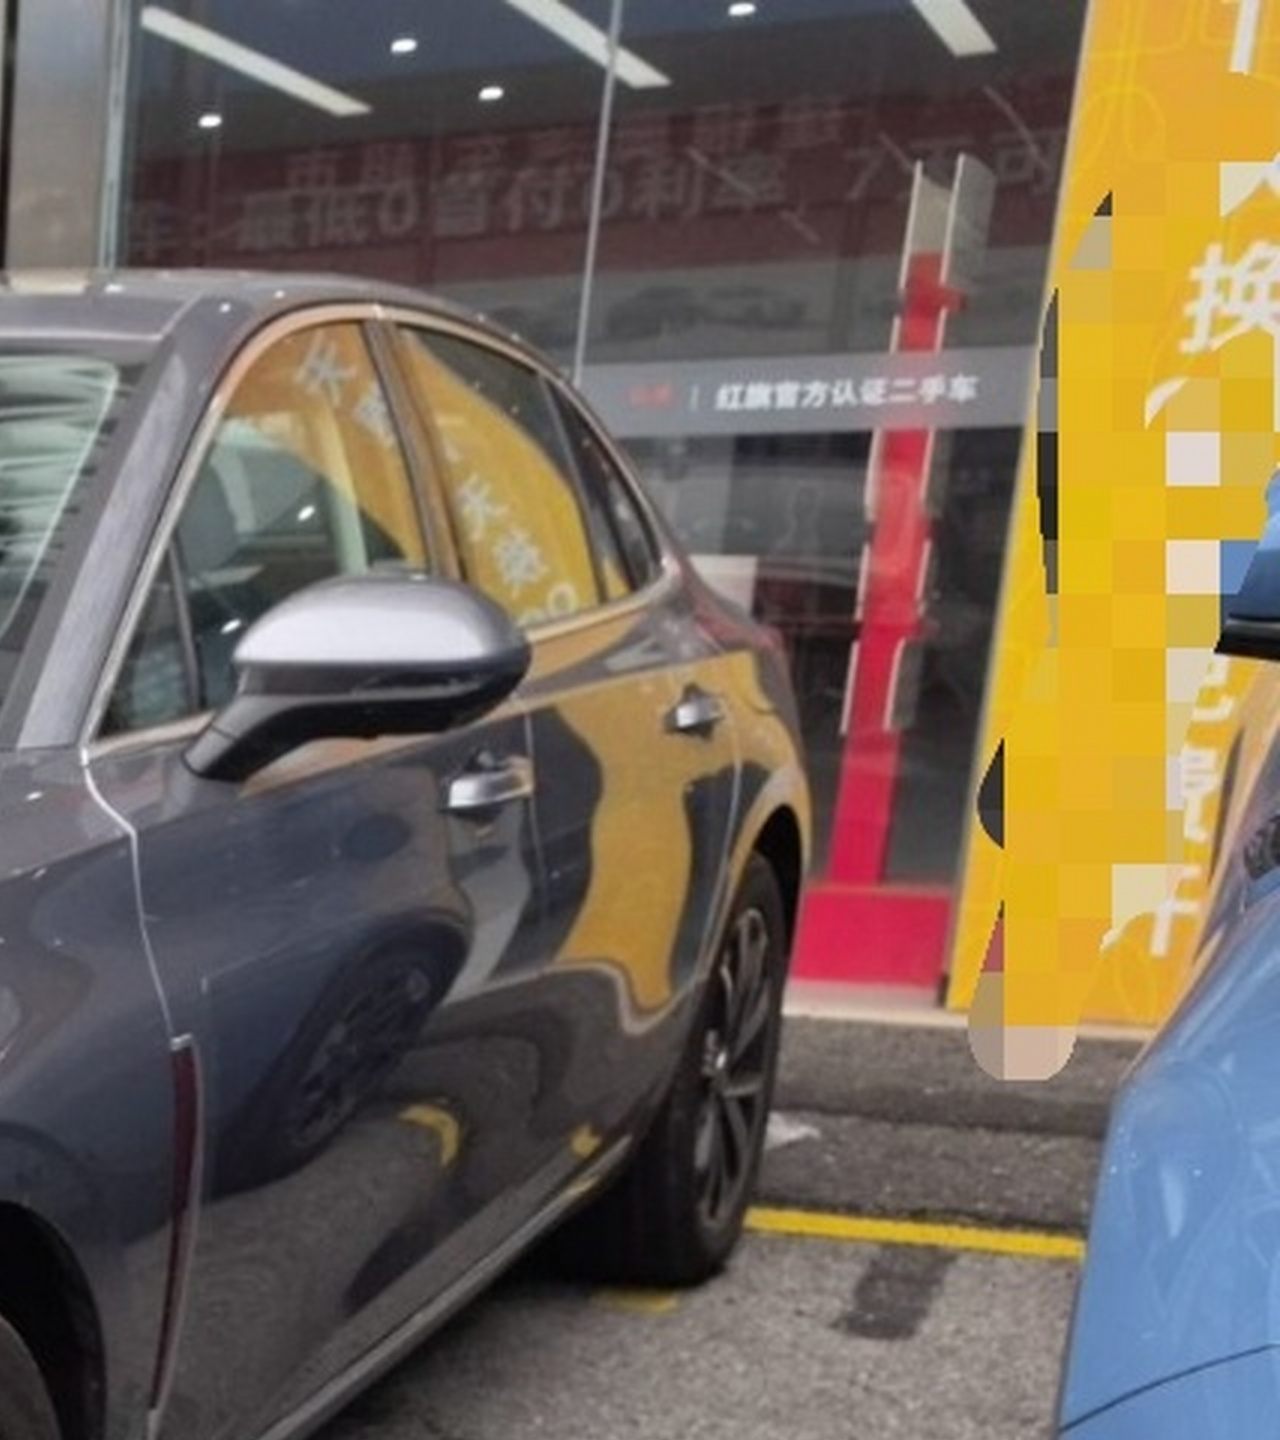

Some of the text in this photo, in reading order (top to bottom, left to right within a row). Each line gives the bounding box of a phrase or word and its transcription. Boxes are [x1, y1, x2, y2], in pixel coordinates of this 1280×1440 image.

[714, 373, 980, 413] 红旗官方认证二手车
